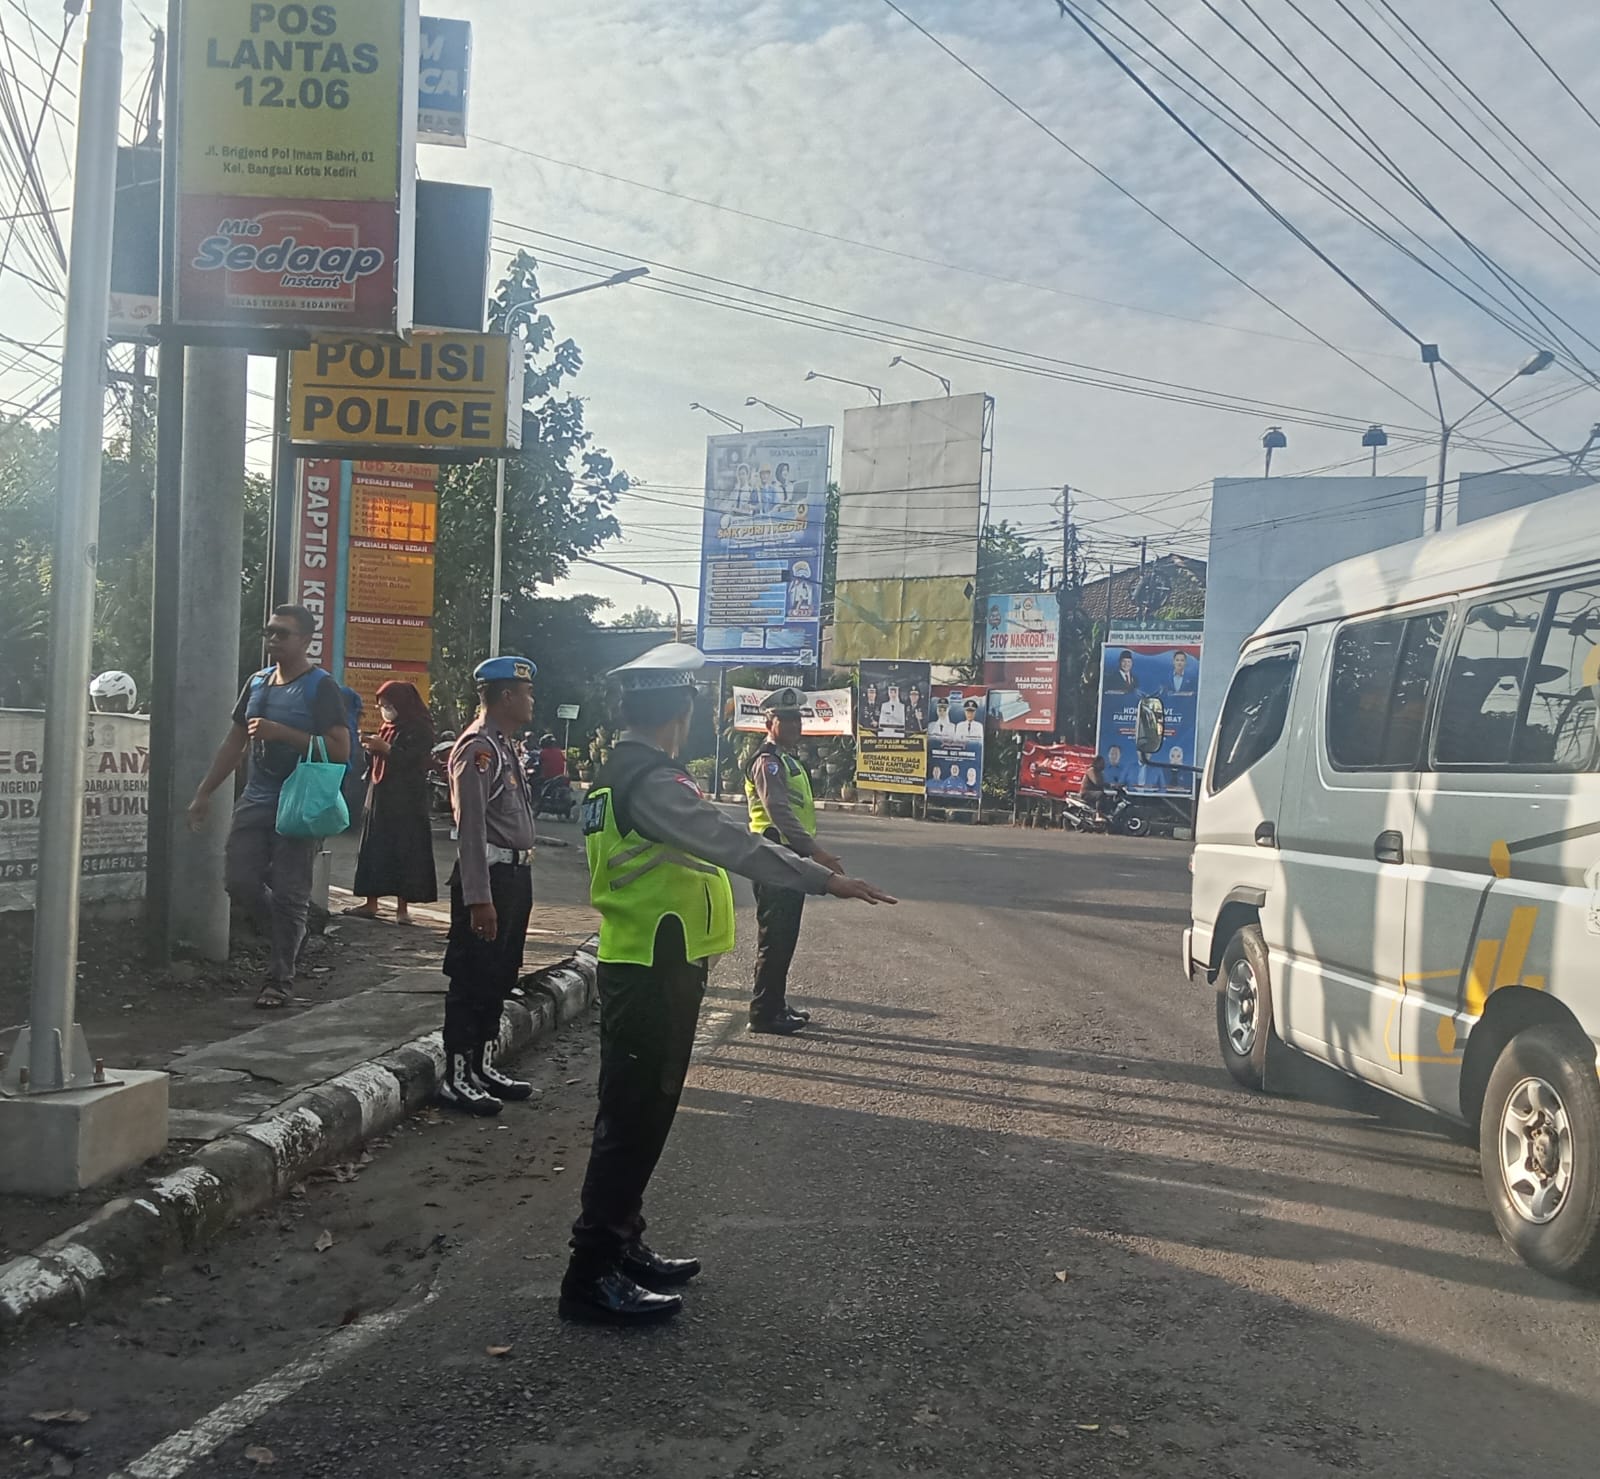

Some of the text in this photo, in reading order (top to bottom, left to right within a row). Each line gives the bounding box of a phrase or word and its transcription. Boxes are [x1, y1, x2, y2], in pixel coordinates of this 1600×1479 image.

[250, 3, 337, 36] POS
[206, 37, 379, 74] LANTAS
[234, 75, 350, 110] 12.06
[222, 146, 269, 159] Brigjend
[272, 148, 290, 159] Pol
[293, 149, 322, 160] Imam
[326, 150, 359, 163] Bahri,
[361, 151, 375, 161] 01
[223, 163, 357, 177] Kel. Bangsal Kota Kediri
[217, 218, 262, 237] Mie
[192, 236, 384, 283] Sedaap
[280, 274, 341, 289] Instant
[317, 342, 485, 382] POLISI
[303, 395, 491, 439] POLICE
[390, 463, 405, 474] 24
[409, 464, 433, 478] Jam
[356, 477, 414, 489] SPESIALIS BEDAH
[304, 475, 330, 569] BAPTIS
[354, 540, 388, 550] SPESIALIS
[389, 543, 404, 551] NON
[350, 616, 381, 624] SPESIALIS
[990, 633, 1009, 649] STOP
[1009, 632, 1045, 649] NARKOBA
[371, 662, 392, 670] UMUM
[0, 799, 40, 819] DIB
